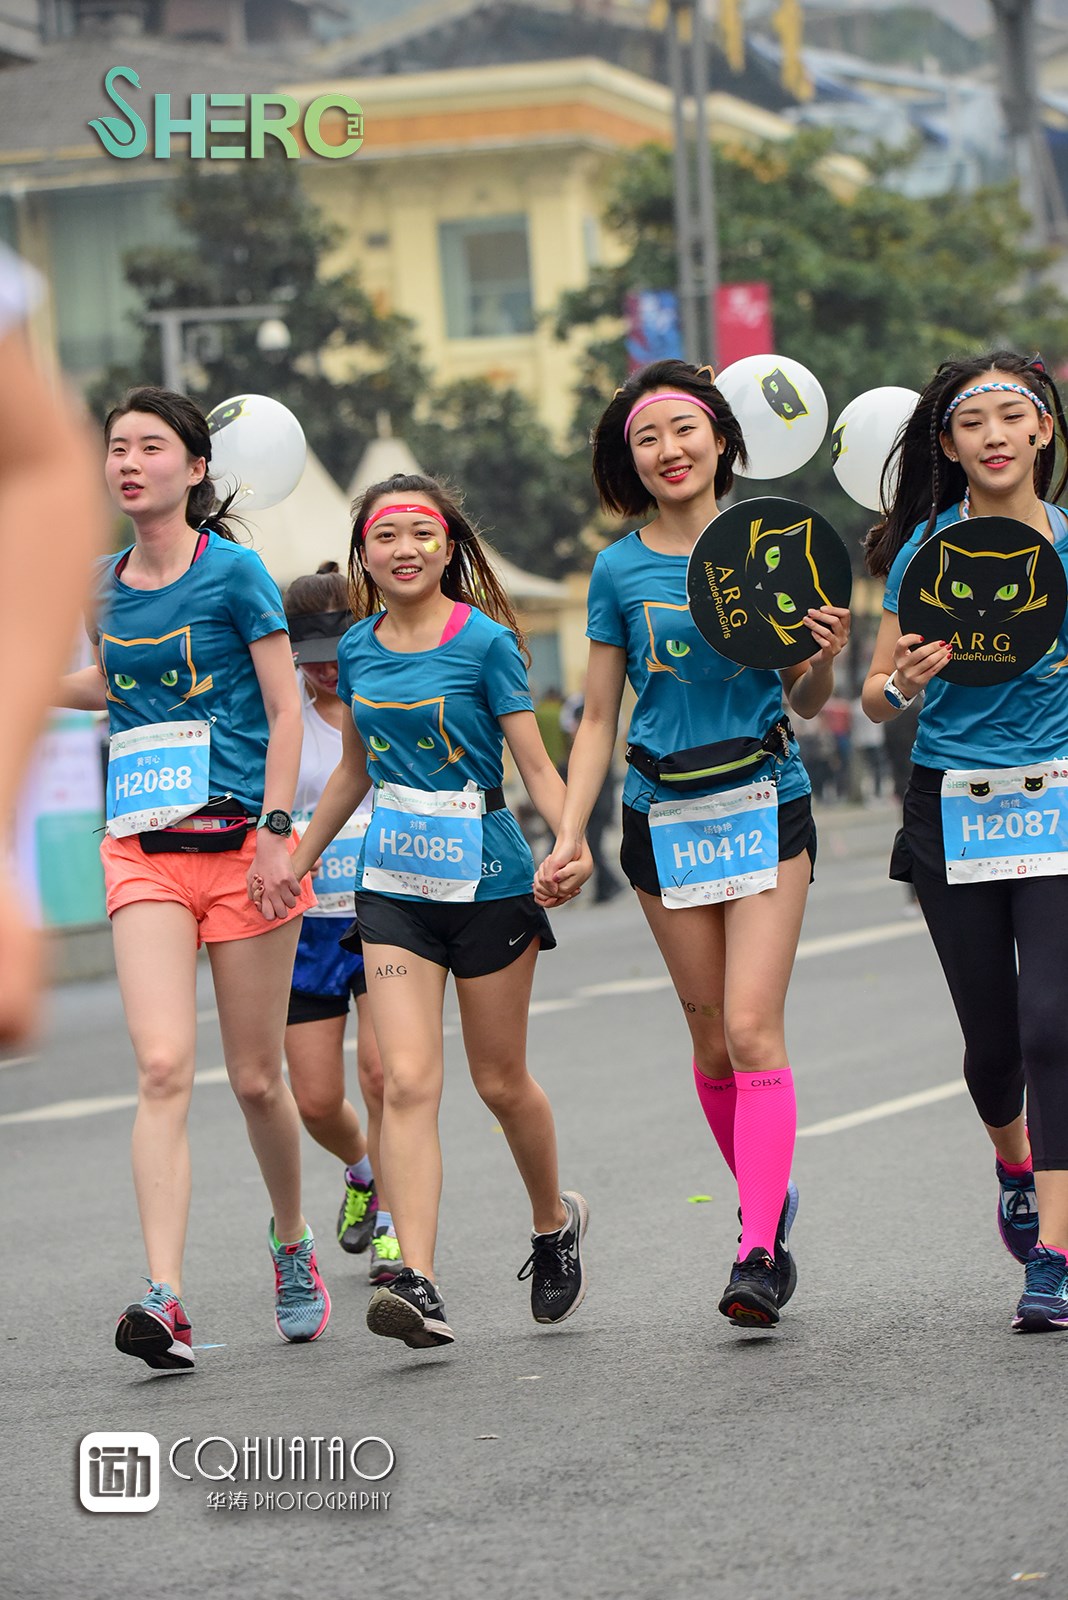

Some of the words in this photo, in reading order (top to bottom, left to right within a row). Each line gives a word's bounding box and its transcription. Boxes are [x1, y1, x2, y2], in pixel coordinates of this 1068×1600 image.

[703, 561, 732, 640] AttitudeRunGirls
[715, 566, 748, 628] ARG
[949, 631, 1011, 651] ARG
[950, 651, 1017, 663] itudeRunGirls
[115, 766, 193, 800] H2088
[961, 809, 1060, 842] H2087
[379, 828, 464, 863] H2085
[673, 830, 763, 869] H0412
[481, 860, 503, 874] RG
[375, 964, 408, 979] ARG
[751, 1077, 782, 1088] OBX
